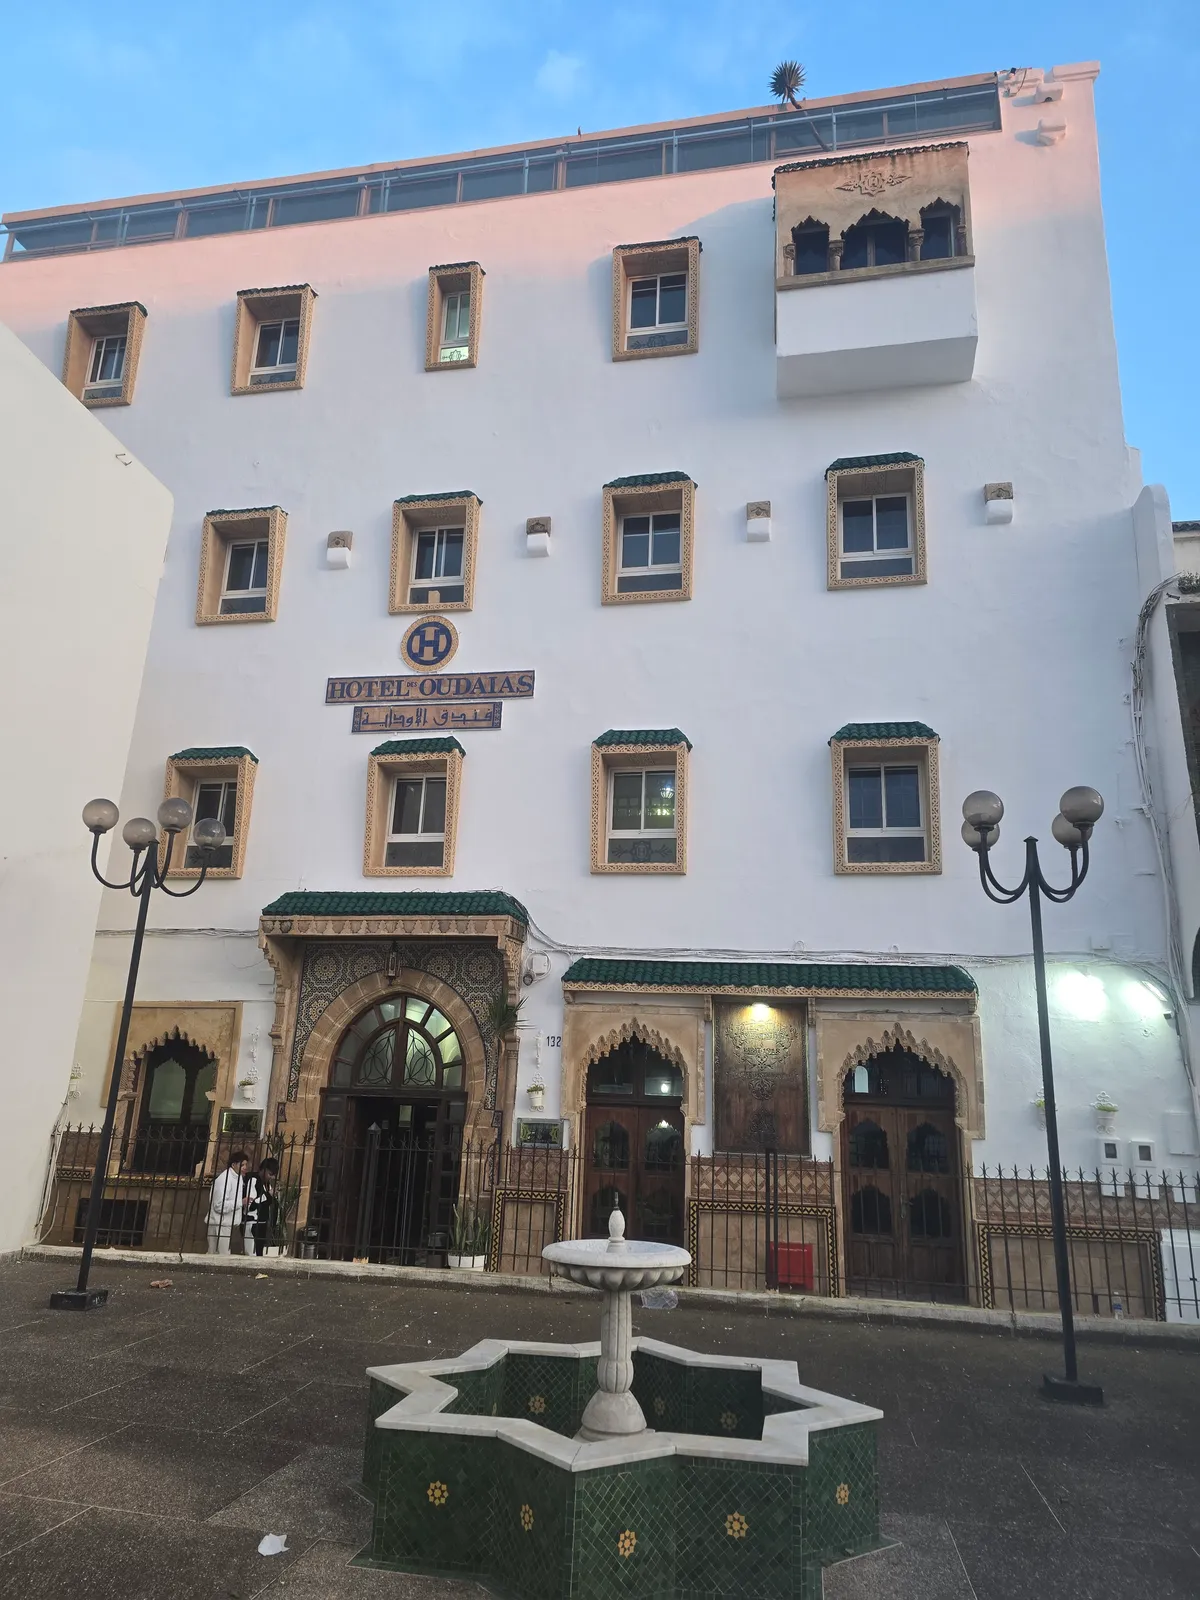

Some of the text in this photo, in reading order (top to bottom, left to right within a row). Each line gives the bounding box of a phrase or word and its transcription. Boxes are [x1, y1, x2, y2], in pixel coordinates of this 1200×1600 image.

[328, 679, 409, 699] HOTEL
[419, 675, 533, 696] OUDAIAS
[433, 708, 493, 726] فندق
[546, 1035, 562, 1048] 132
